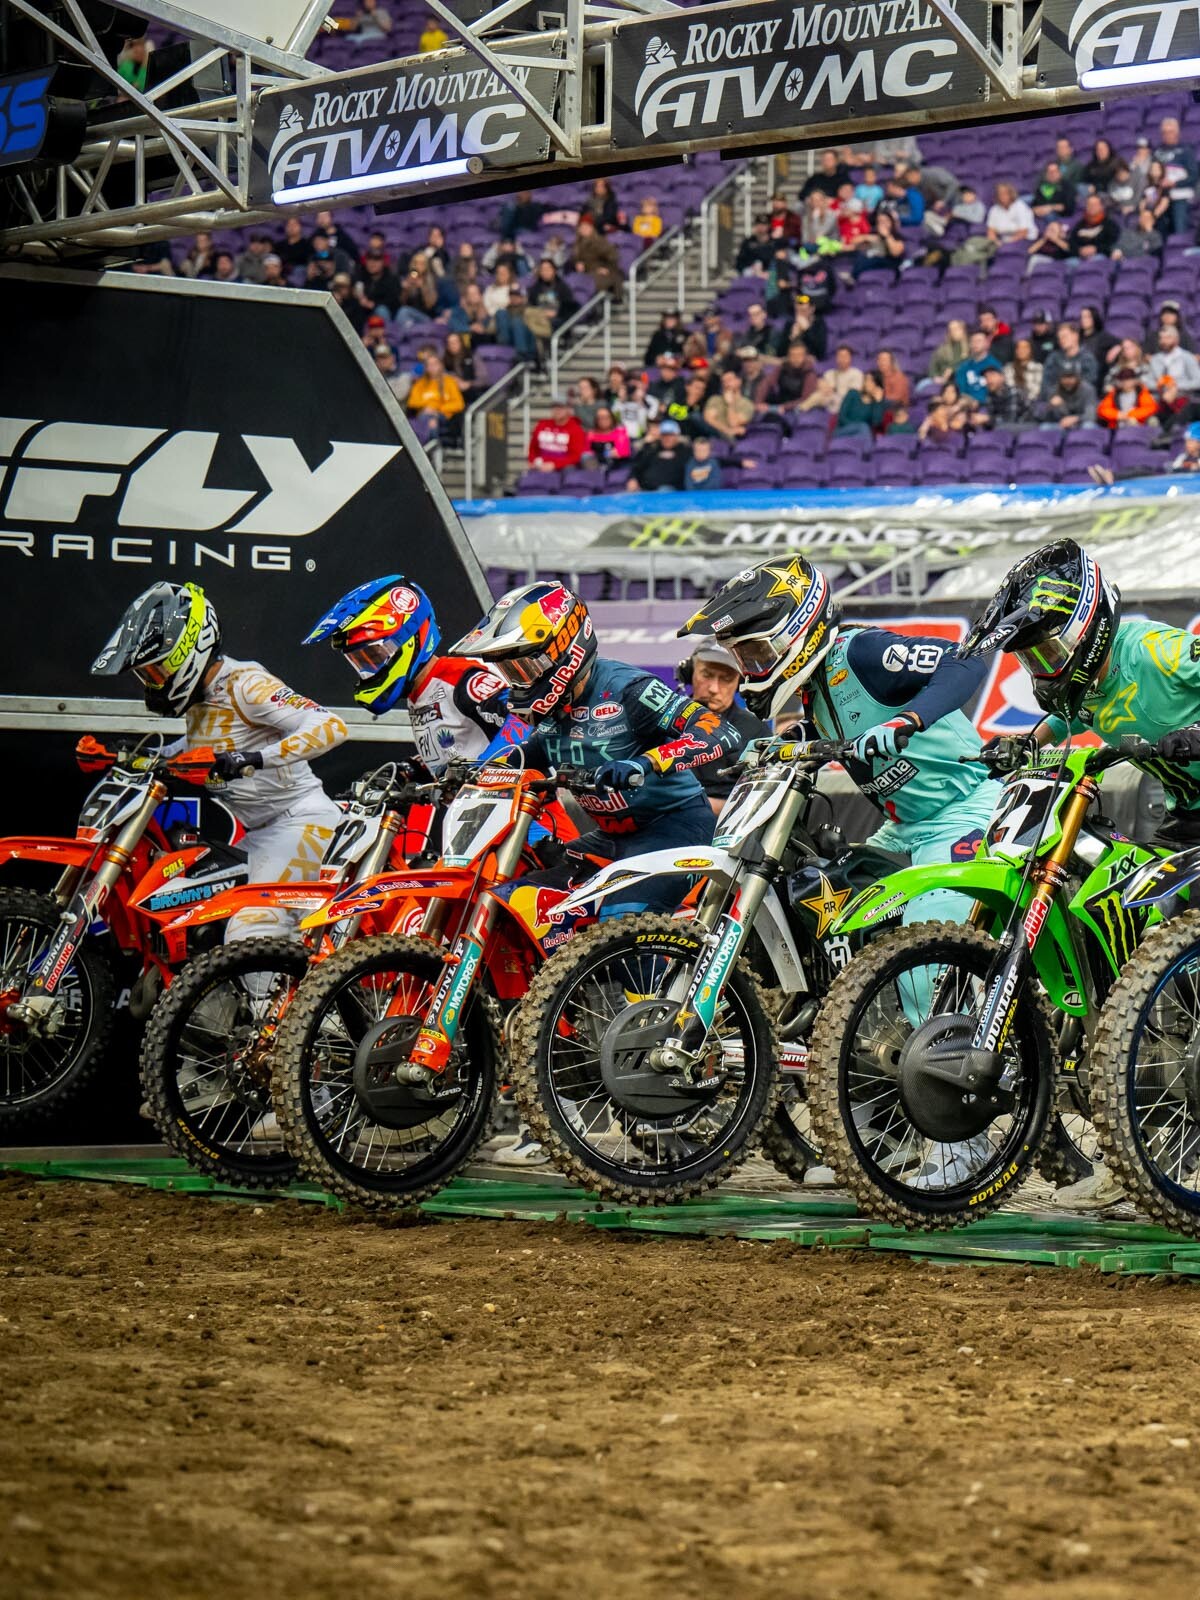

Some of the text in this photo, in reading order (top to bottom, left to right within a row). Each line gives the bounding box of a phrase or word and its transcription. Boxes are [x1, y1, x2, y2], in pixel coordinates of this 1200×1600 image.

[684, 18, 782, 66] ROCKY
[801, 39, 959, 111] MC
[309, 84, 387, 131] ROCKY
[397, 103, 527, 167] MC
[0, 418, 403, 536] FLY
[0, 530, 291, 571] RACING
[787, 581, 824, 637] SCOTT
[1079, 555, 1097, 624] SCOTT
[546, 600, 588, 662] 100%
[782, 620, 828, 680] ROCKSTAR
[595, 705, 620, 717] BELL
[986, 783, 1065, 846] 21
[162, 857, 185, 879] COLE
[322, 819, 368, 866] 12
[150, 886, 213, 912] BROWN'S
[41, 924, 70, 977] DUNLOP
[45, 941, 75, 992] BRAKING
[635, 933, 700, 950] DUNLOP
[706, 930, 740, 988] MOTOREX
[450, 955, 478, 1010] MOTOREX
[983, 964, 1019, 1052] DUNLOP
[969, 1161, 1020, 1207] DUNLOP
